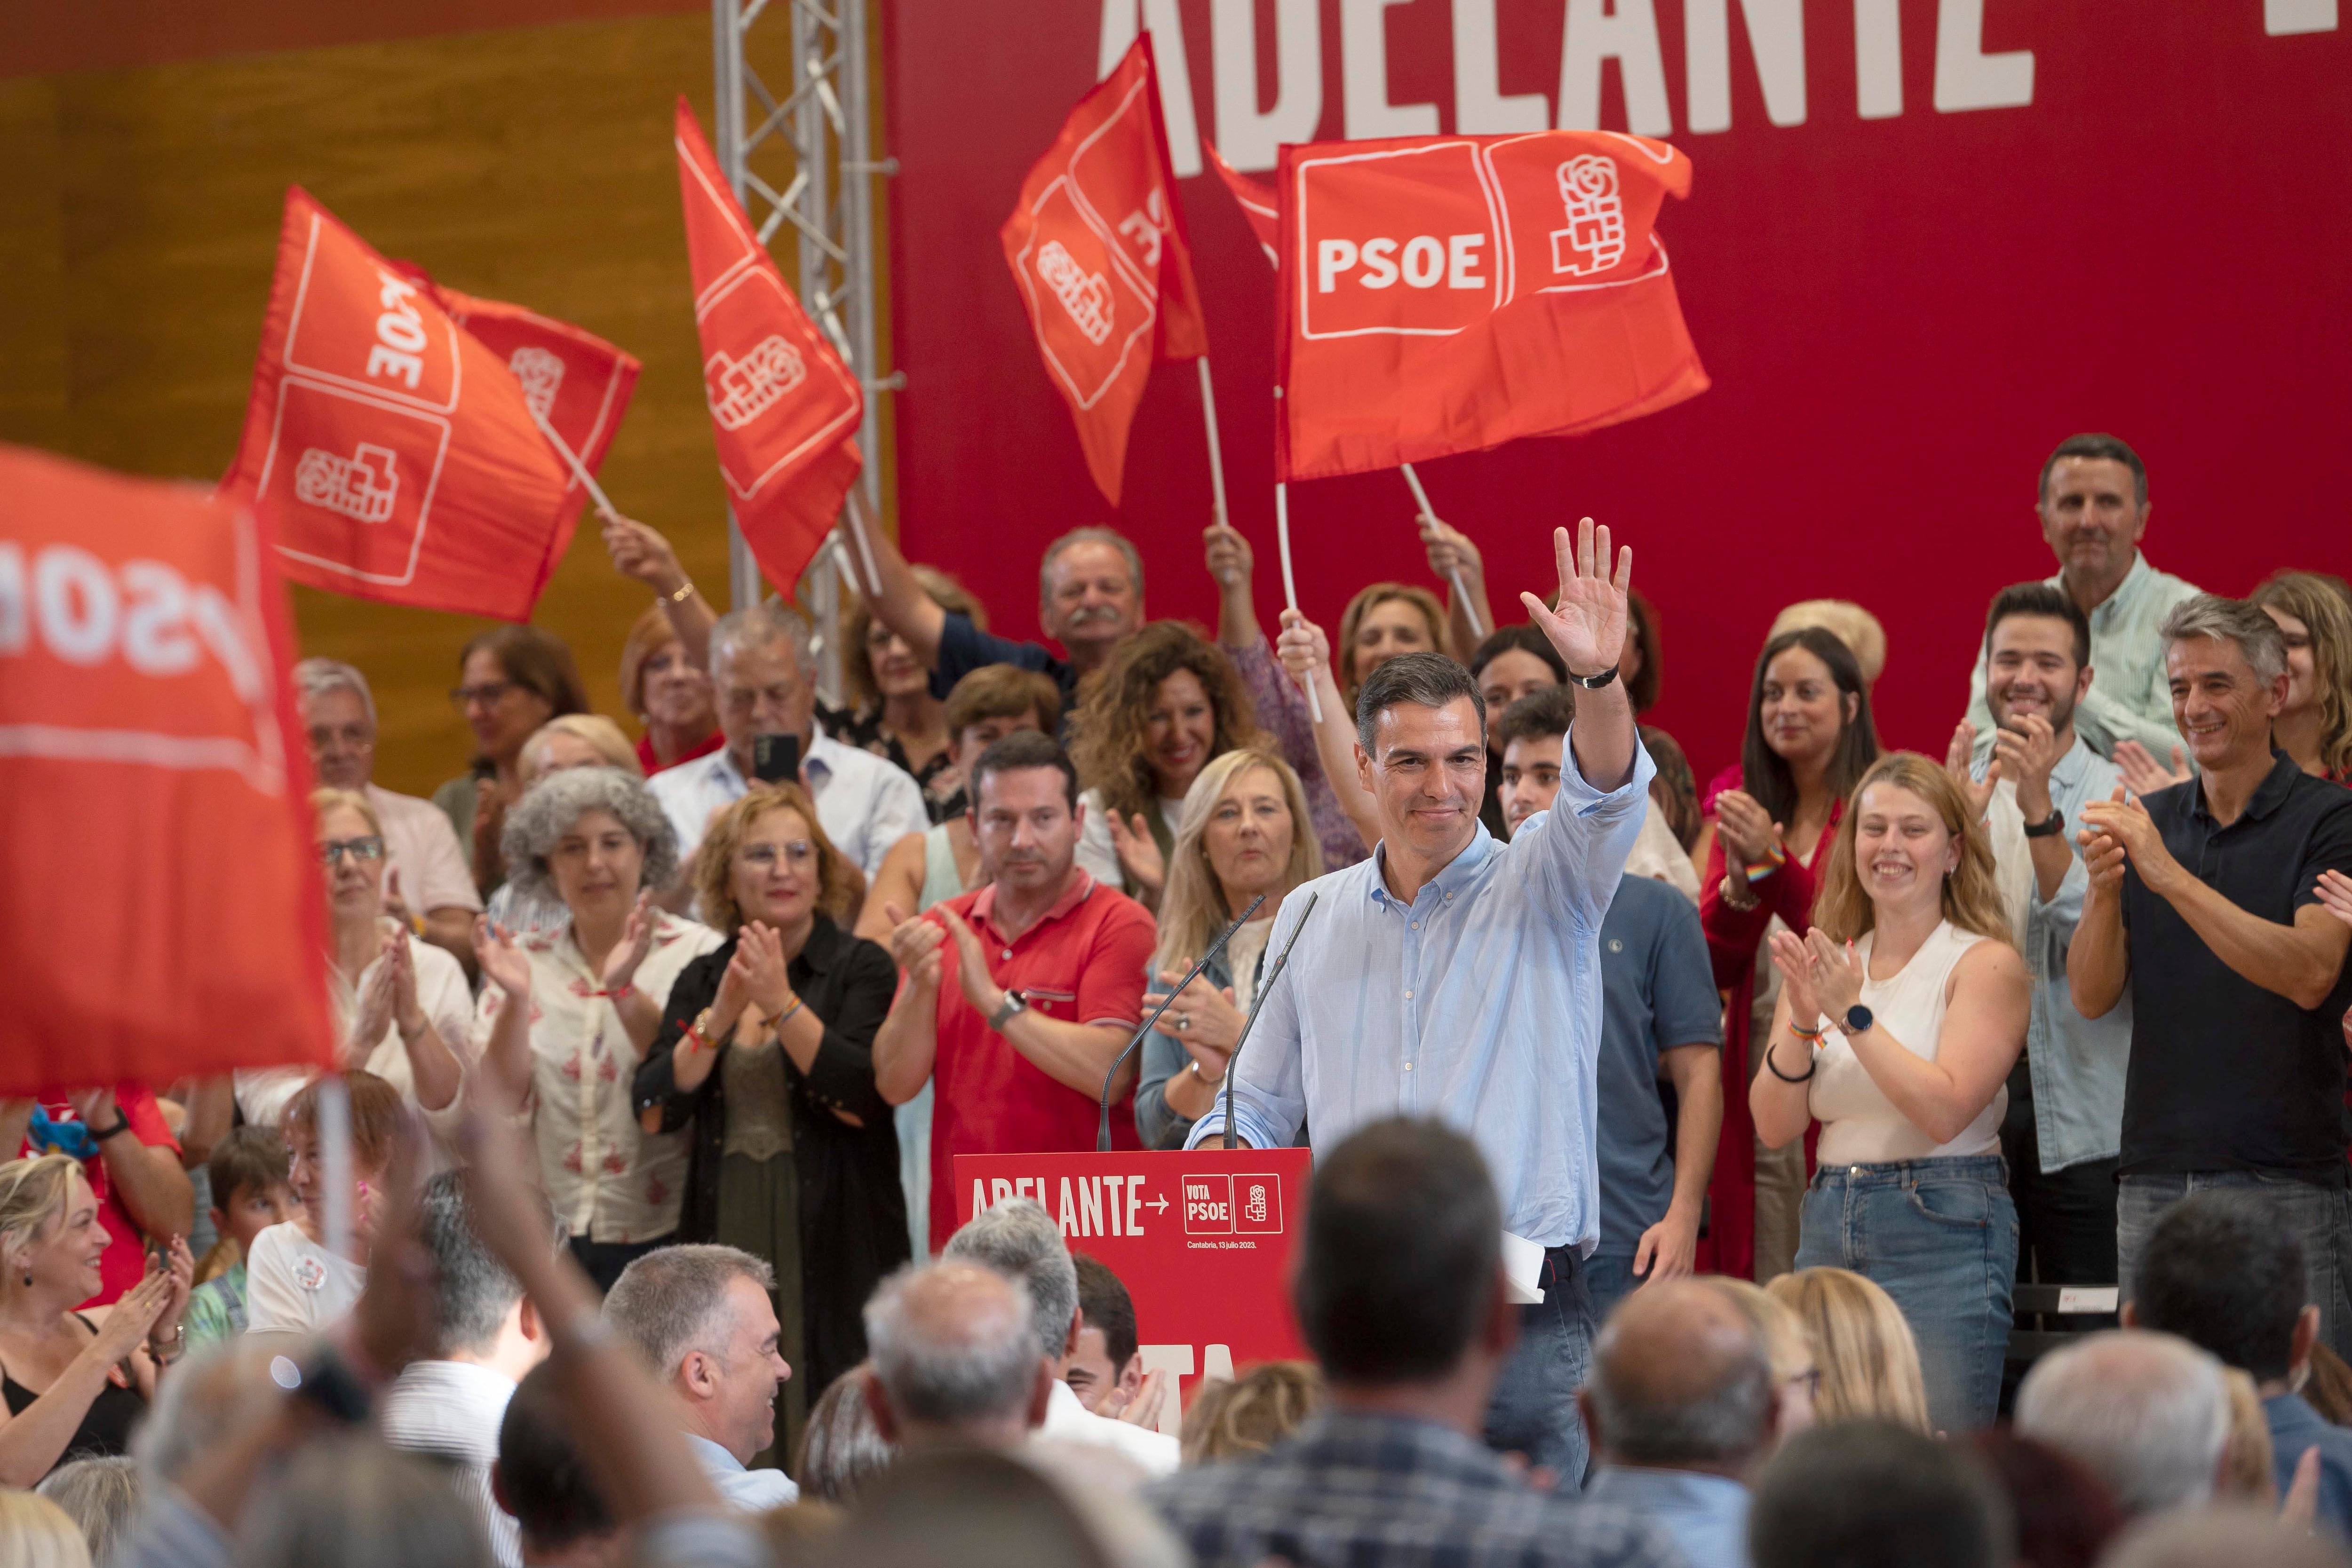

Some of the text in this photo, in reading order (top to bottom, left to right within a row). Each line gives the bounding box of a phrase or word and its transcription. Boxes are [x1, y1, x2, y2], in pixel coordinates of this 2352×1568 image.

[1319, 233, 1486, 293] PSOE
[1186, 1185, 1210, 1200] VOTA
[1188, 1203, 1229, 1220] PSOE
[1187, 1241, 1218, 1250] Cantabria,
[1226, 1241, 1239, 1250] julio
